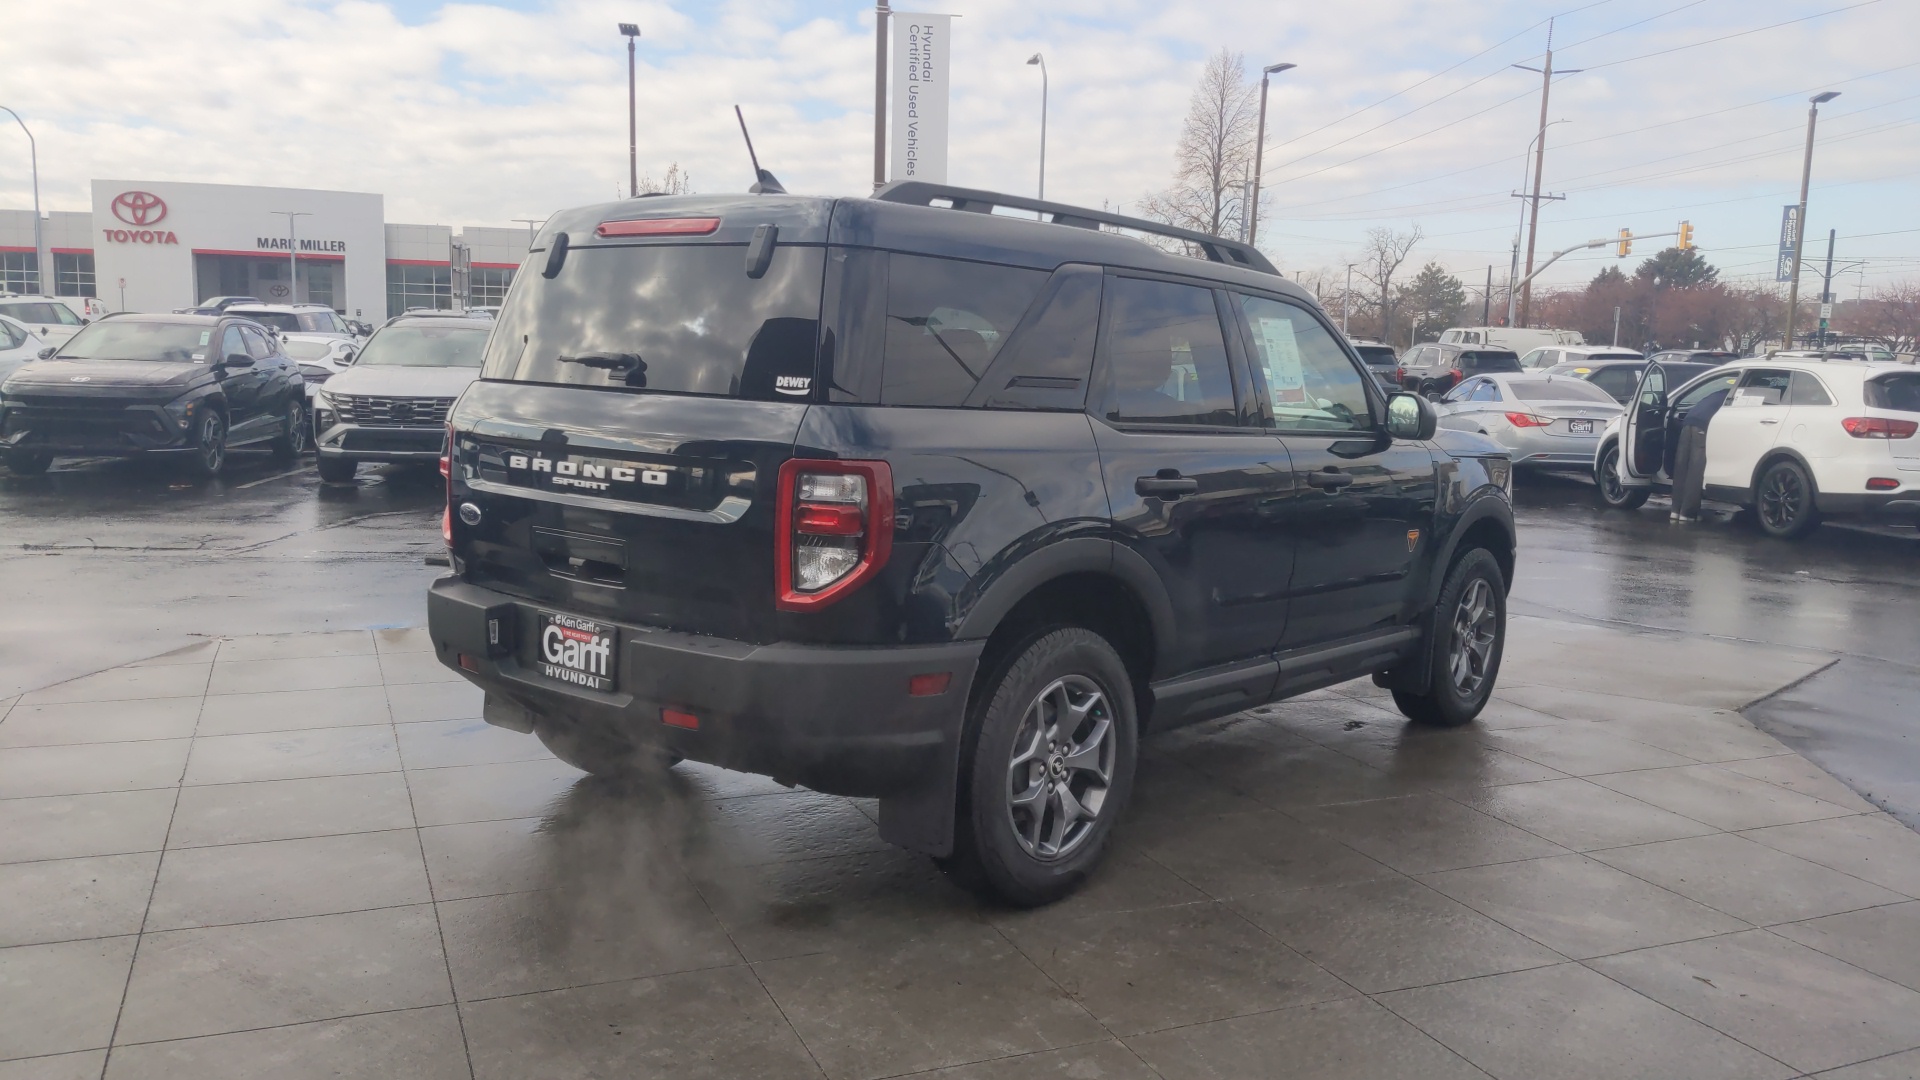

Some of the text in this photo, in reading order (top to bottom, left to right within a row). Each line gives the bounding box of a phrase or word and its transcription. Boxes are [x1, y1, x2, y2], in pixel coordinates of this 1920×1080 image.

[921, 25, 933, 82] Hyundai
[906, 24, 920, 176] Certified Used Vehicles
[103, 229, 178, 245] TOYOTA
[300, 239, 346, 251] MILLER
[776, 376, 811, 388] DEWEY
[509, 455, 668, 485] BRONCO
[552, 476, 610, 490] SPORT
[561, 615, 595, 632] Ken Garff
[543, 625, 610, 676] Garff
[545, 665, 600, 689] HYUNDAI
